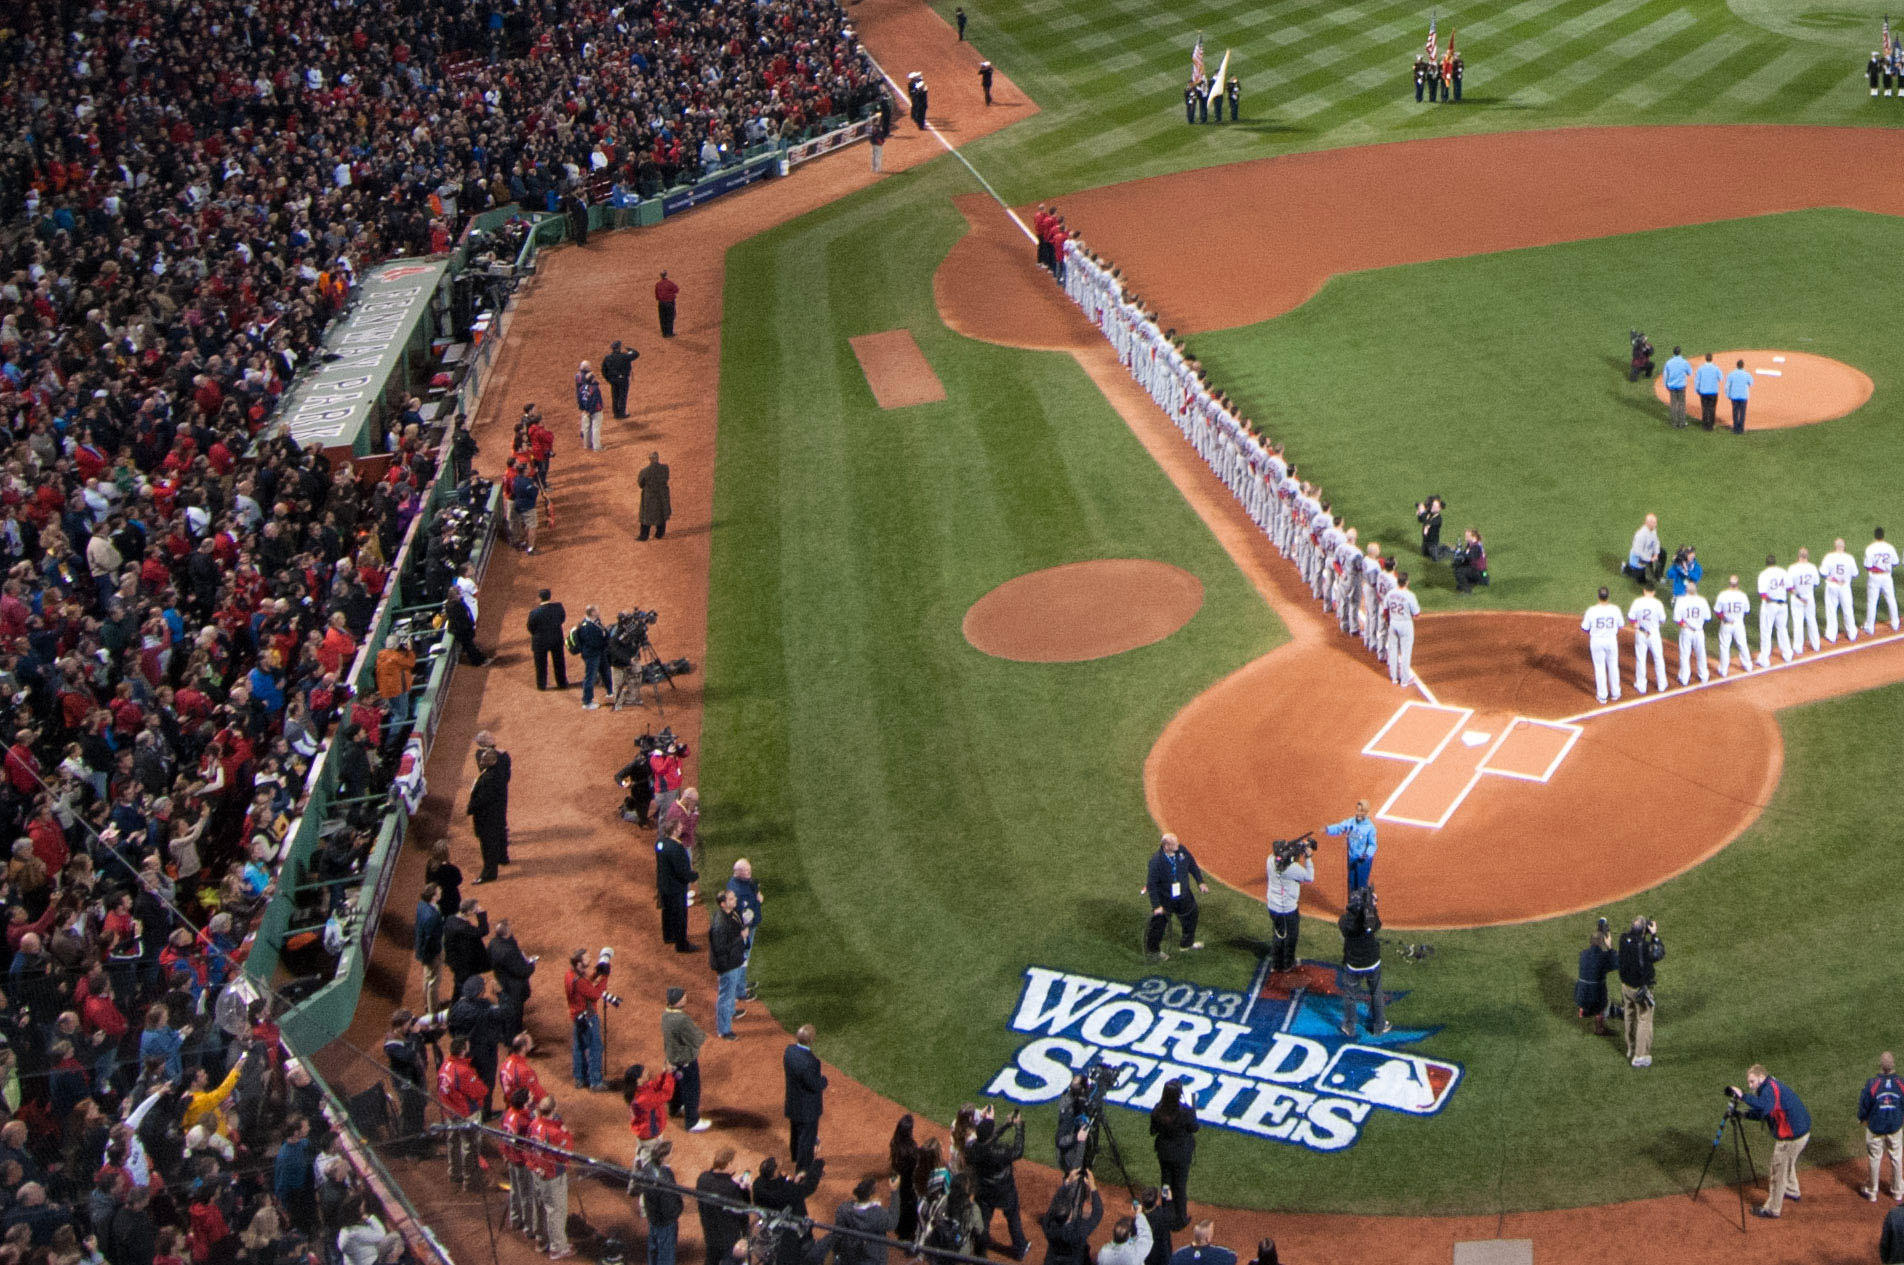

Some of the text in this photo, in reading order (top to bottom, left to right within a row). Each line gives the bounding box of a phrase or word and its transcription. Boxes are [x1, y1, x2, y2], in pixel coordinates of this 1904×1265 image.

[290, 286, 422, 442] FENWAY PARK
[1874, 553, 1891, 564] 72
[1836, 564, 1845, 575] 5
[1799, 574, 1812, 586] 12
[1389, 601, 1405, 616] 22
[1685, 607, 1700, 620] 18
[1727, 601, 1742, 613] 15
[1642, 608, 1652, 621] 2
[1132, 979, 1243, 1021] 2013
[1011, 967, 1330, 1085] WORLD
[988, 1036, 1373, 1152] SERIES
